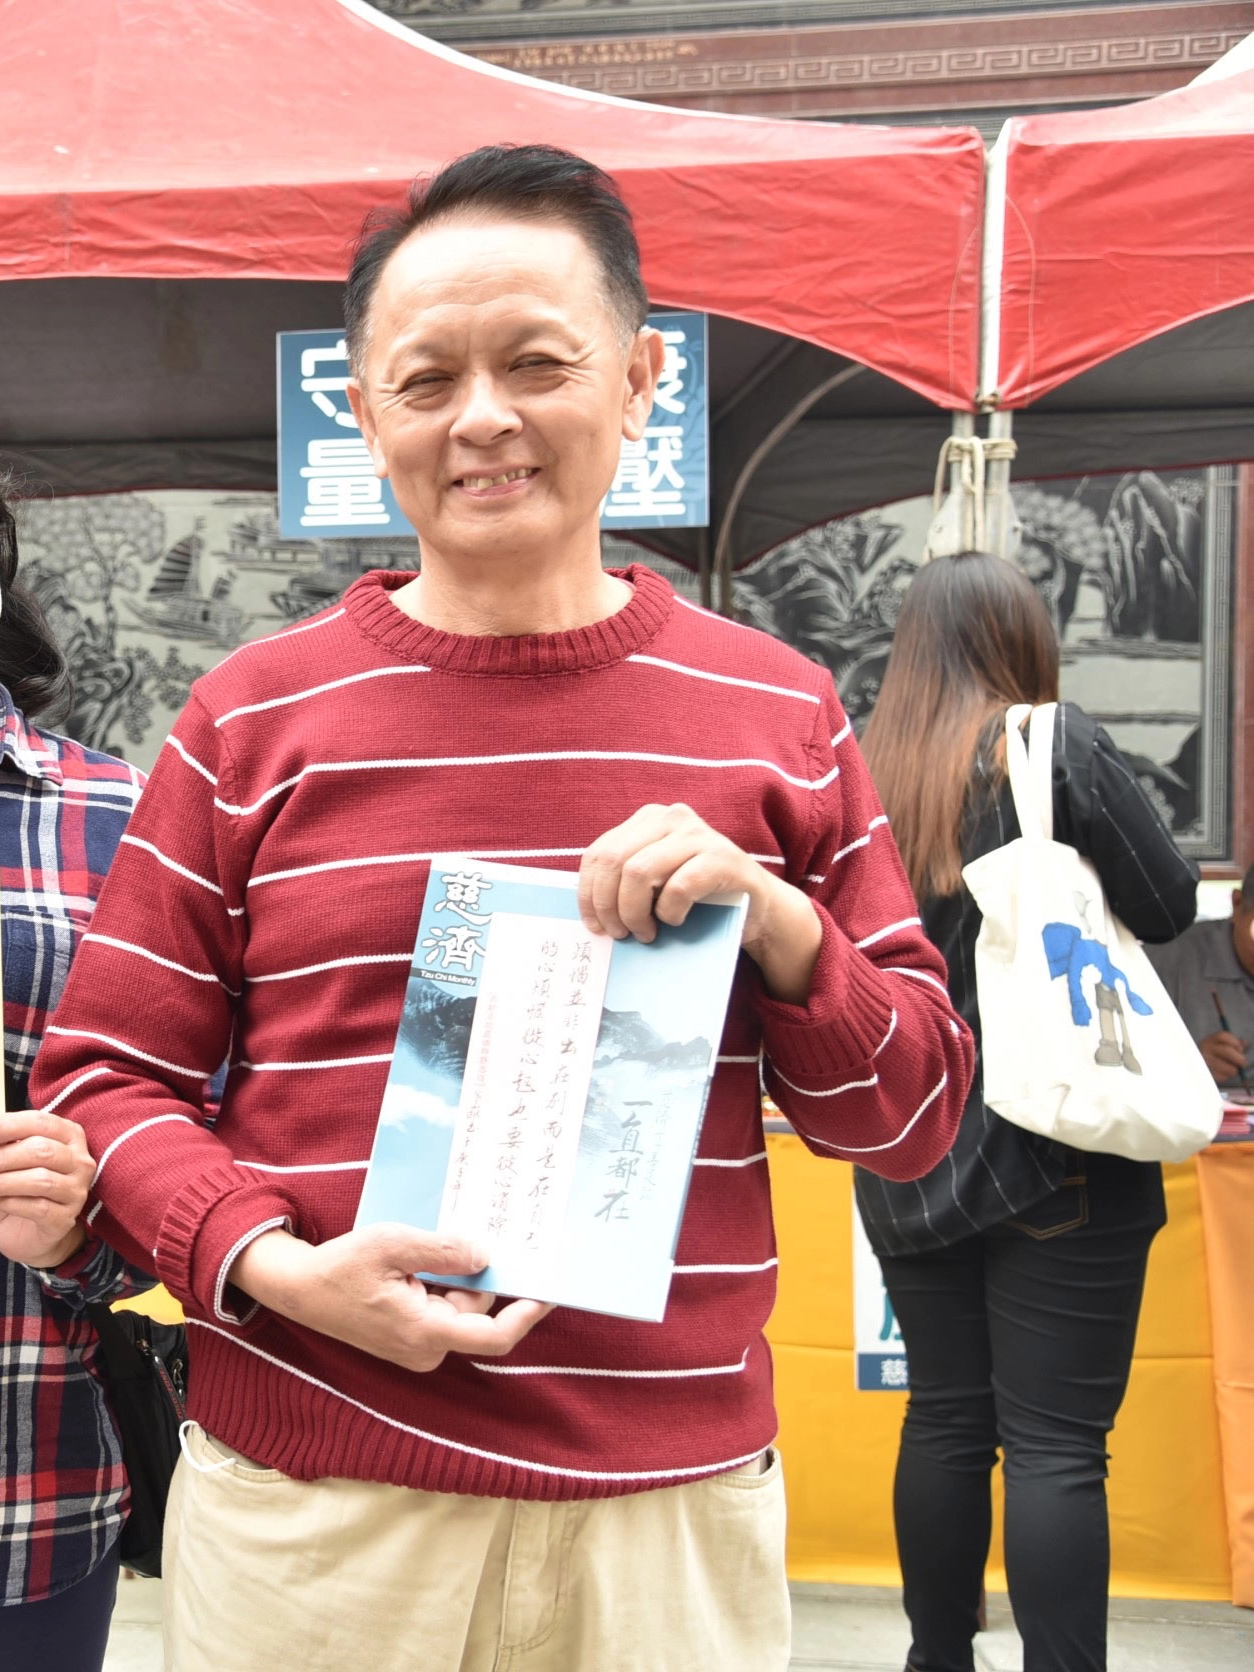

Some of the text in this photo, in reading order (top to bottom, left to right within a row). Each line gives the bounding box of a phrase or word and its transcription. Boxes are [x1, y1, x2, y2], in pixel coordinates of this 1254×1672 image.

[421, 870, 493, 971] 慈濟
[420, 970, 434, 979] Tzu
[448, 975, 475, 986] Monthly
[593, 1100, 654, 1223] 一直都在
